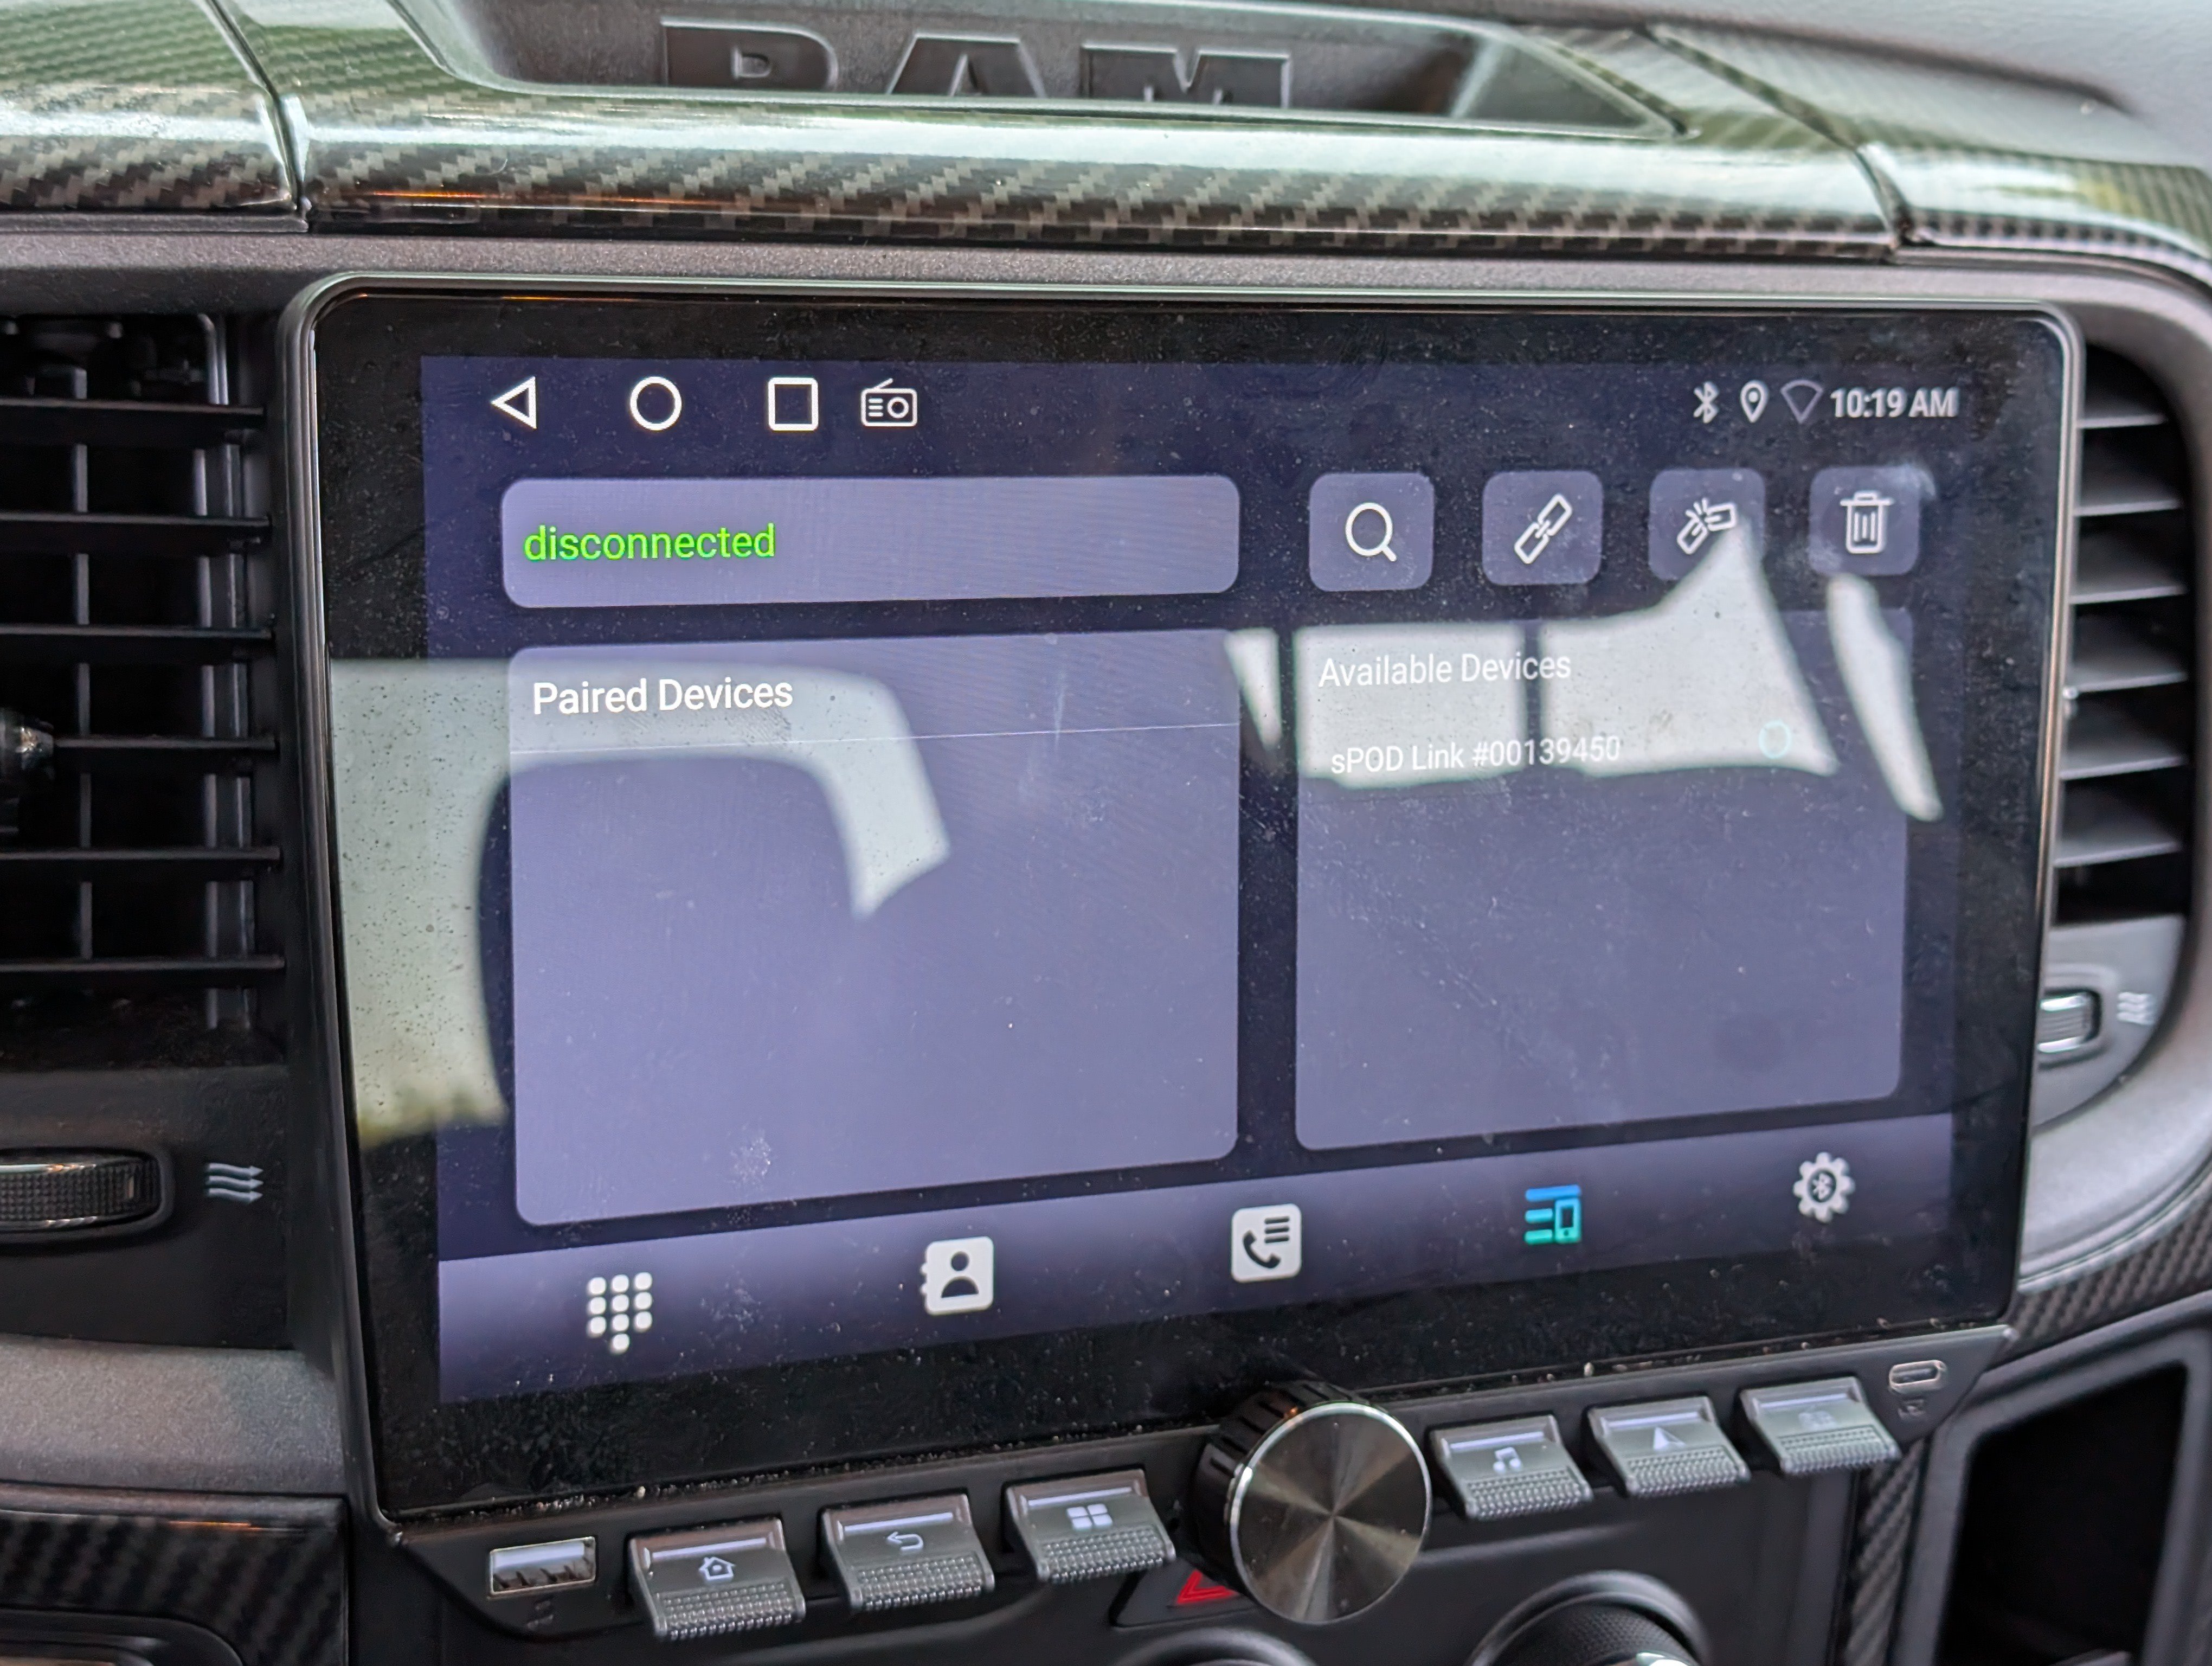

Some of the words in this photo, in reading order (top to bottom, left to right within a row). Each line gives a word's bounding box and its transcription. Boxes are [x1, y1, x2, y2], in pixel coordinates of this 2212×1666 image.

[1830, 387, 1907, 418] 10:19
[1908, 387, 1959, 418] AM
[524, 522, 776, 561] disconnected
[1319, 653, 1452, 687] Available
[1462, 652, 1571, 682] Devices
[533, 678, 647, 715] Paired
[659, 677, 793, 711] Devices
[1332, 746, 1403, 774] sPOD
[1412, 741, 1464, 770] Link
[1472, 736, 1621, 767] #00139450
